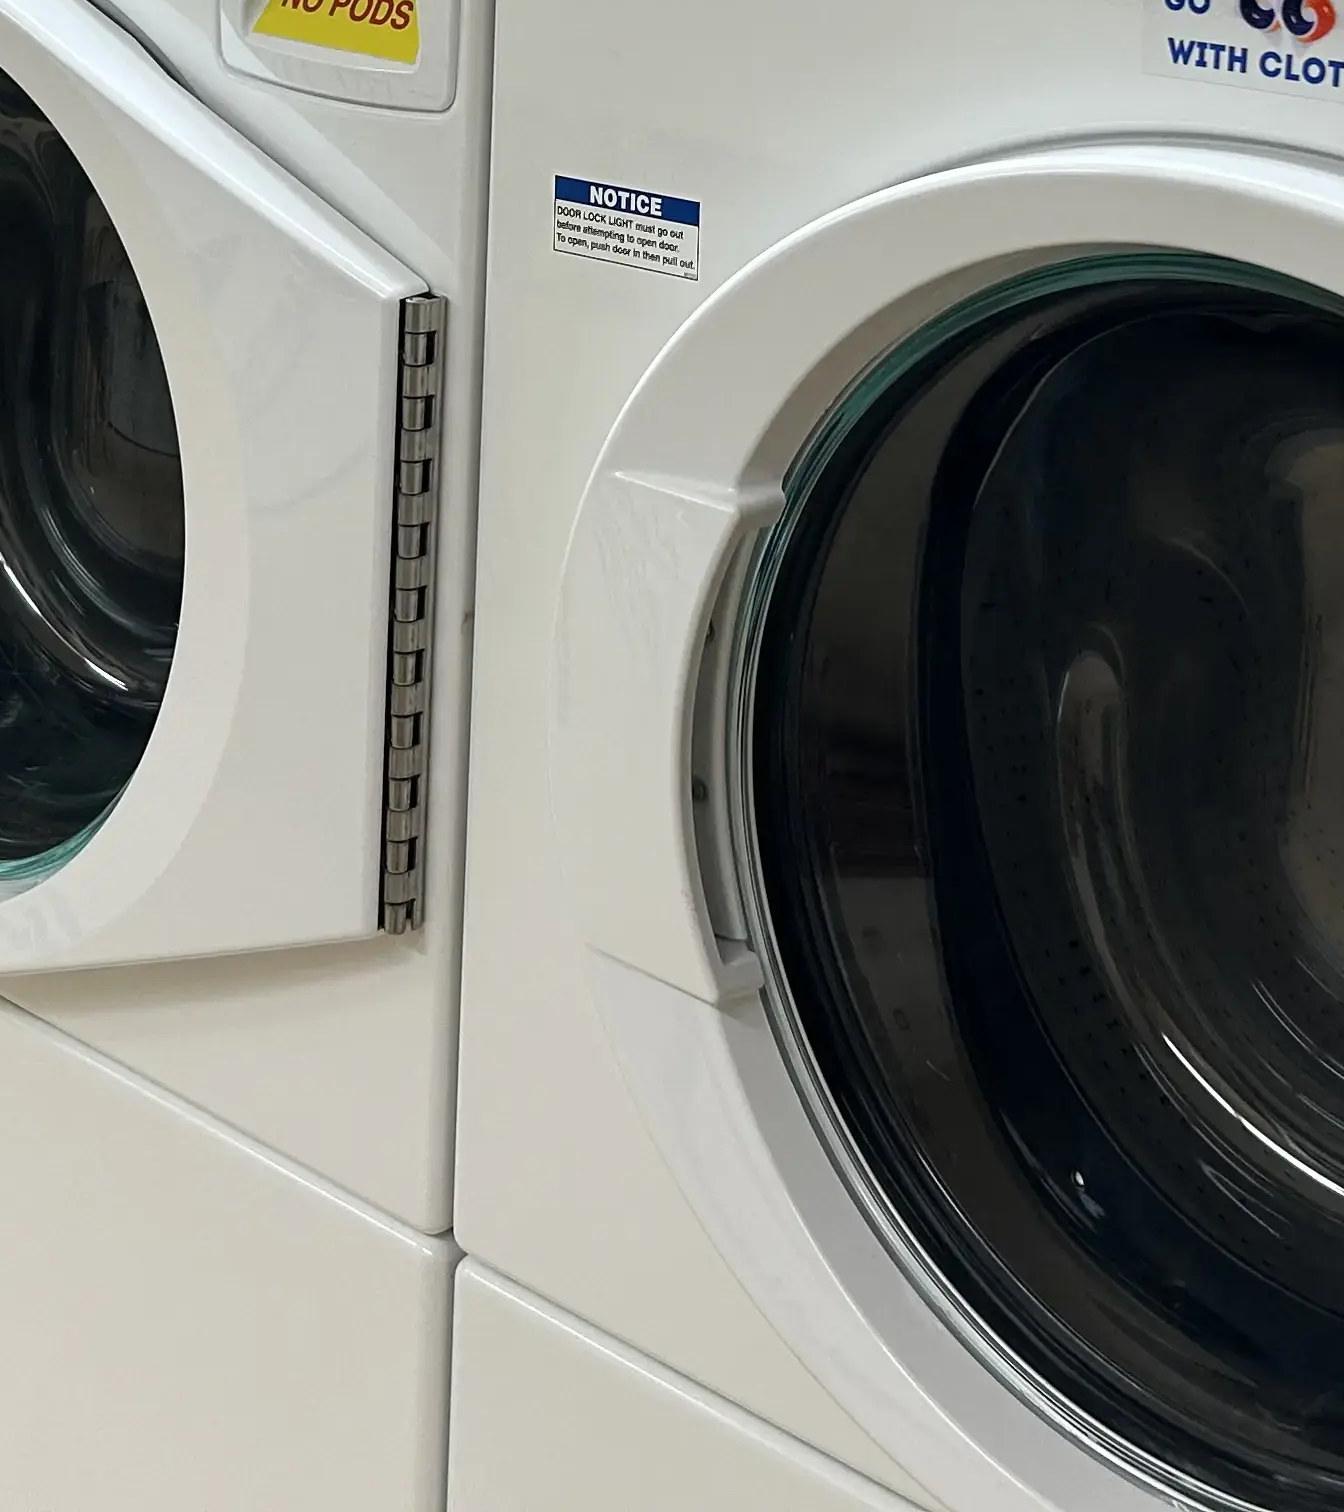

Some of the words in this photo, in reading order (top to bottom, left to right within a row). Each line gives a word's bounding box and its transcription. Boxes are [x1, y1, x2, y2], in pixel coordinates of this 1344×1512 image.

[1167, 37, 1248, 73] WITH
[589, 185, 663, 217] NOTICE
[557, 206, 581, 219] DOOR
[583, 211, 606, 224] LOCK
[609, 215, 633, 229] LIGHT
[636, 223, 655, 234] must
[657, 228, 668, 238] go
[670, 229, 684, 240] out
[557, 219, 581, 232] before
[583, 225, 624, 244] attempting
[626, 233, 635, 243] to
[636, 237, 656, 249] open
[556, 232, 565, 243] To
[591, 240, 610, 252] push
[612, 245, 631, 257] door
[633, 248, 640, 258] in
[643, 251, 660, 262] then
[662, 255, 677, 267] pull
